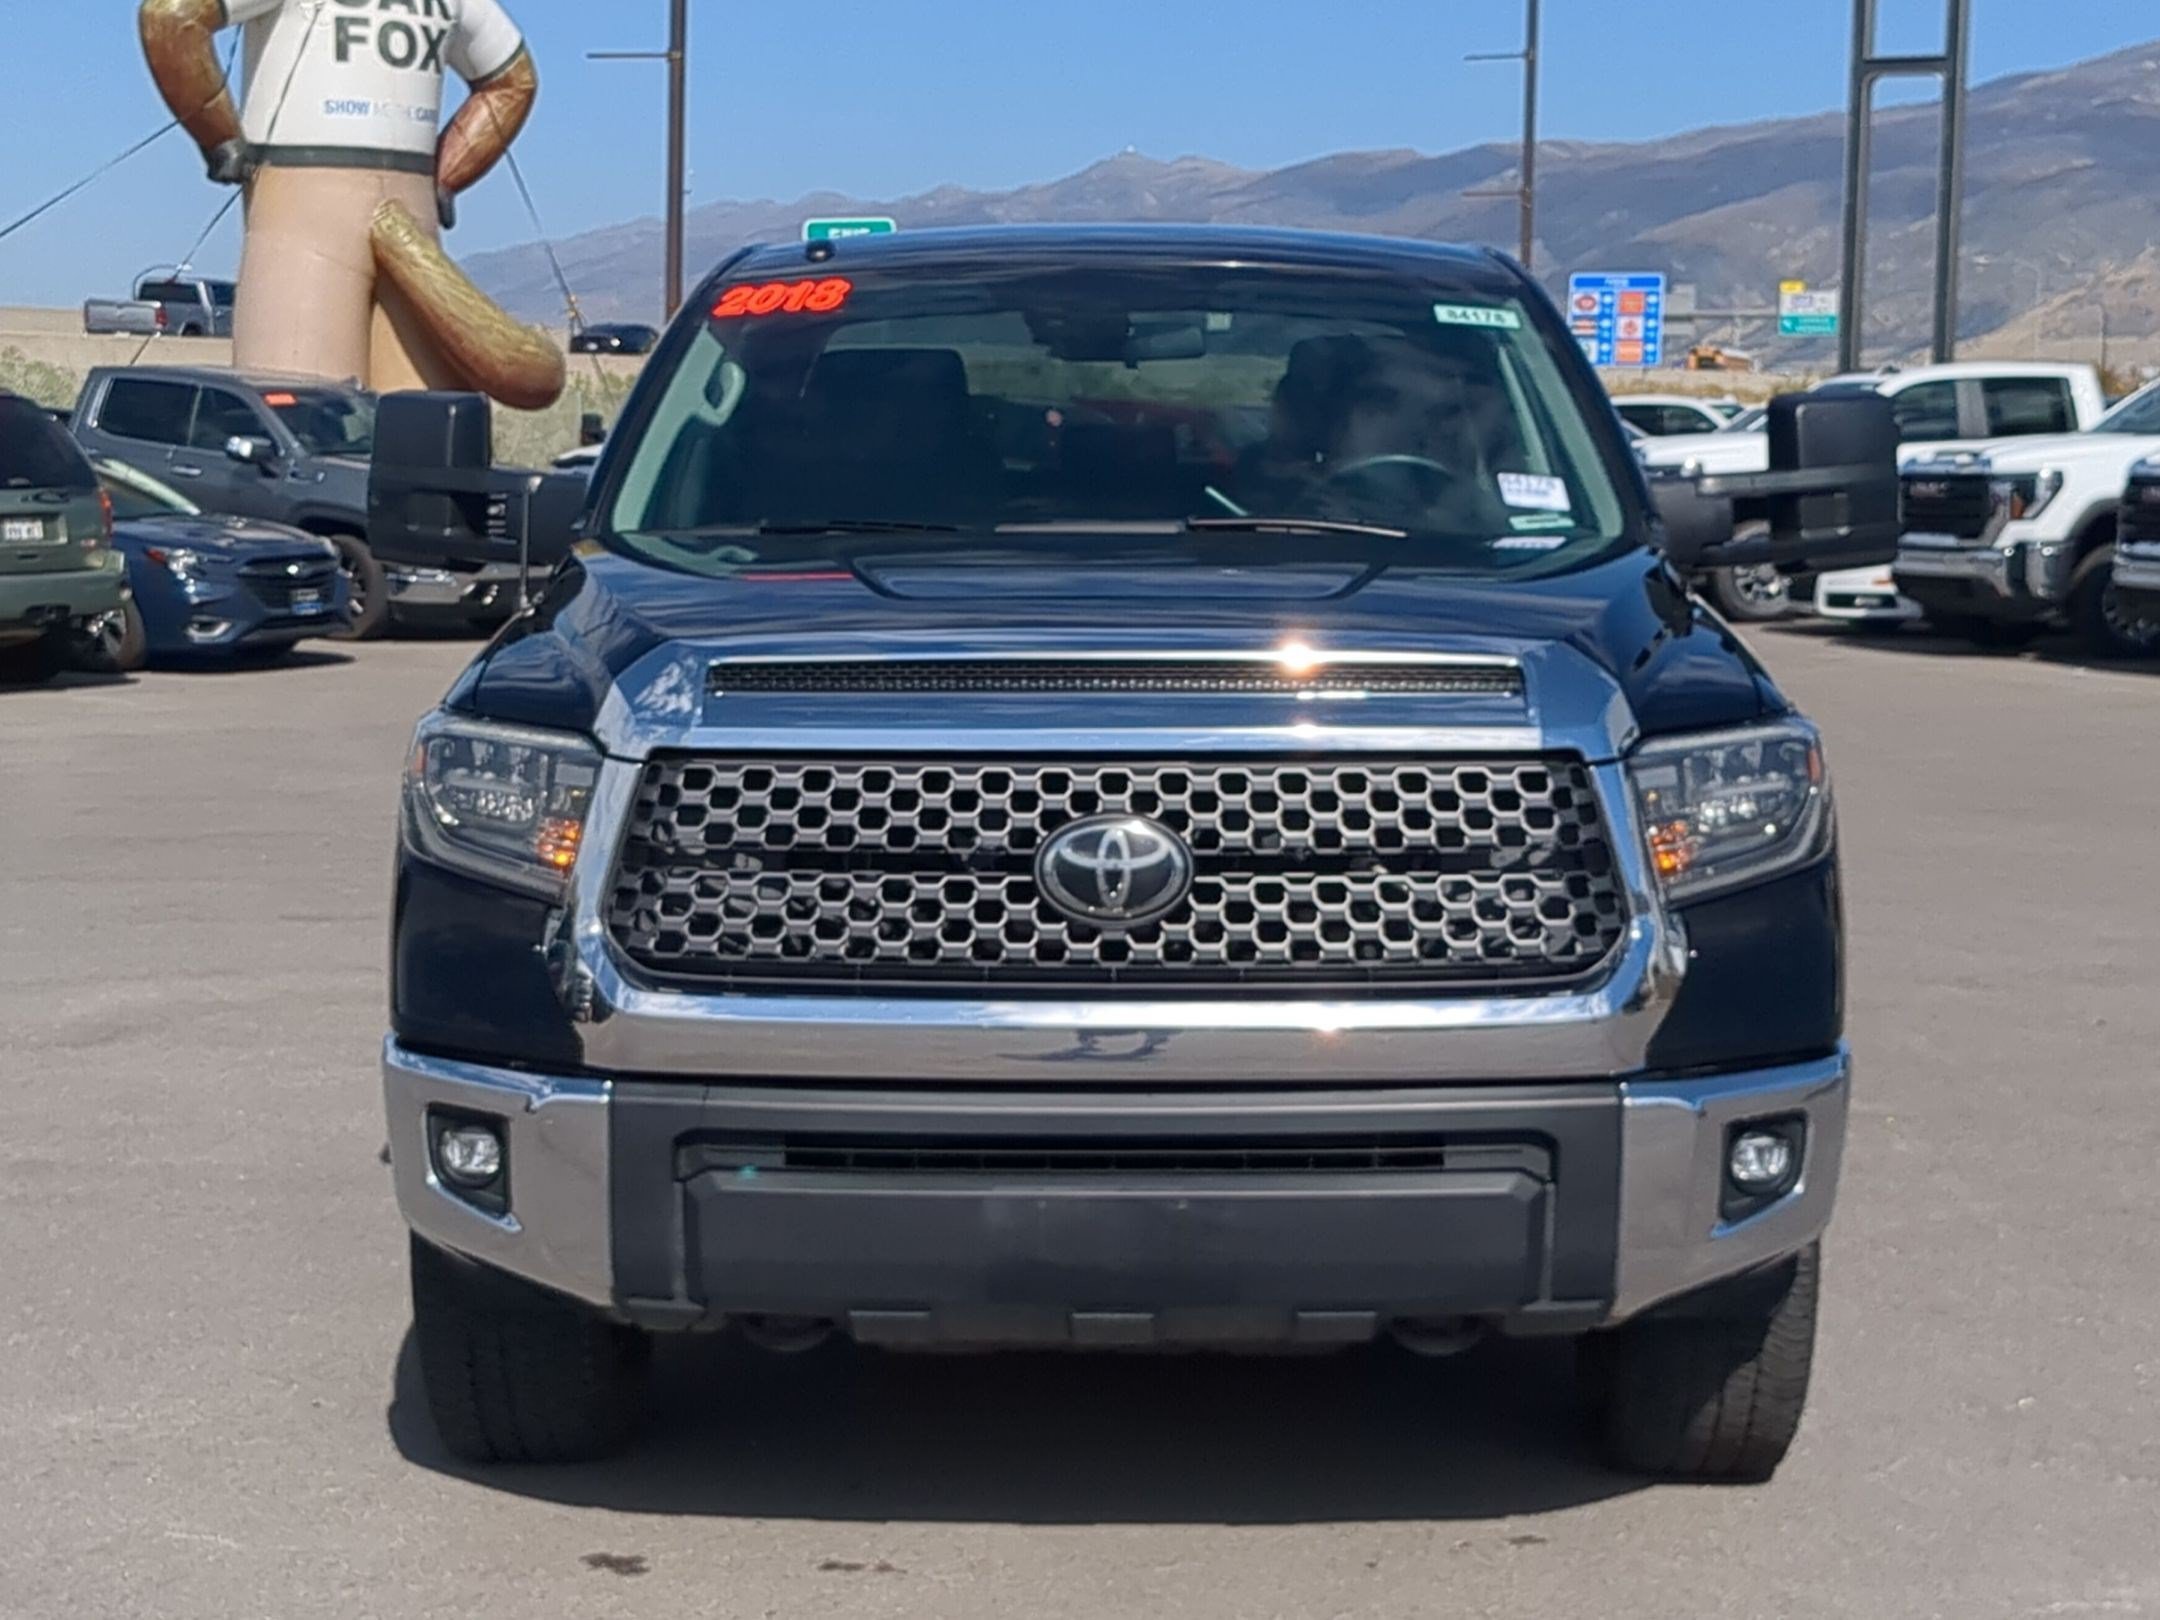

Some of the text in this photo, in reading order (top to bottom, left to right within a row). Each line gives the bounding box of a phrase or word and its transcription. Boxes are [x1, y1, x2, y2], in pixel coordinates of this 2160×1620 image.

[334, 16, 448, 74] FOX
[324, 99, 371, 116] SHOW
[713, 278, 851, 317] 2018
